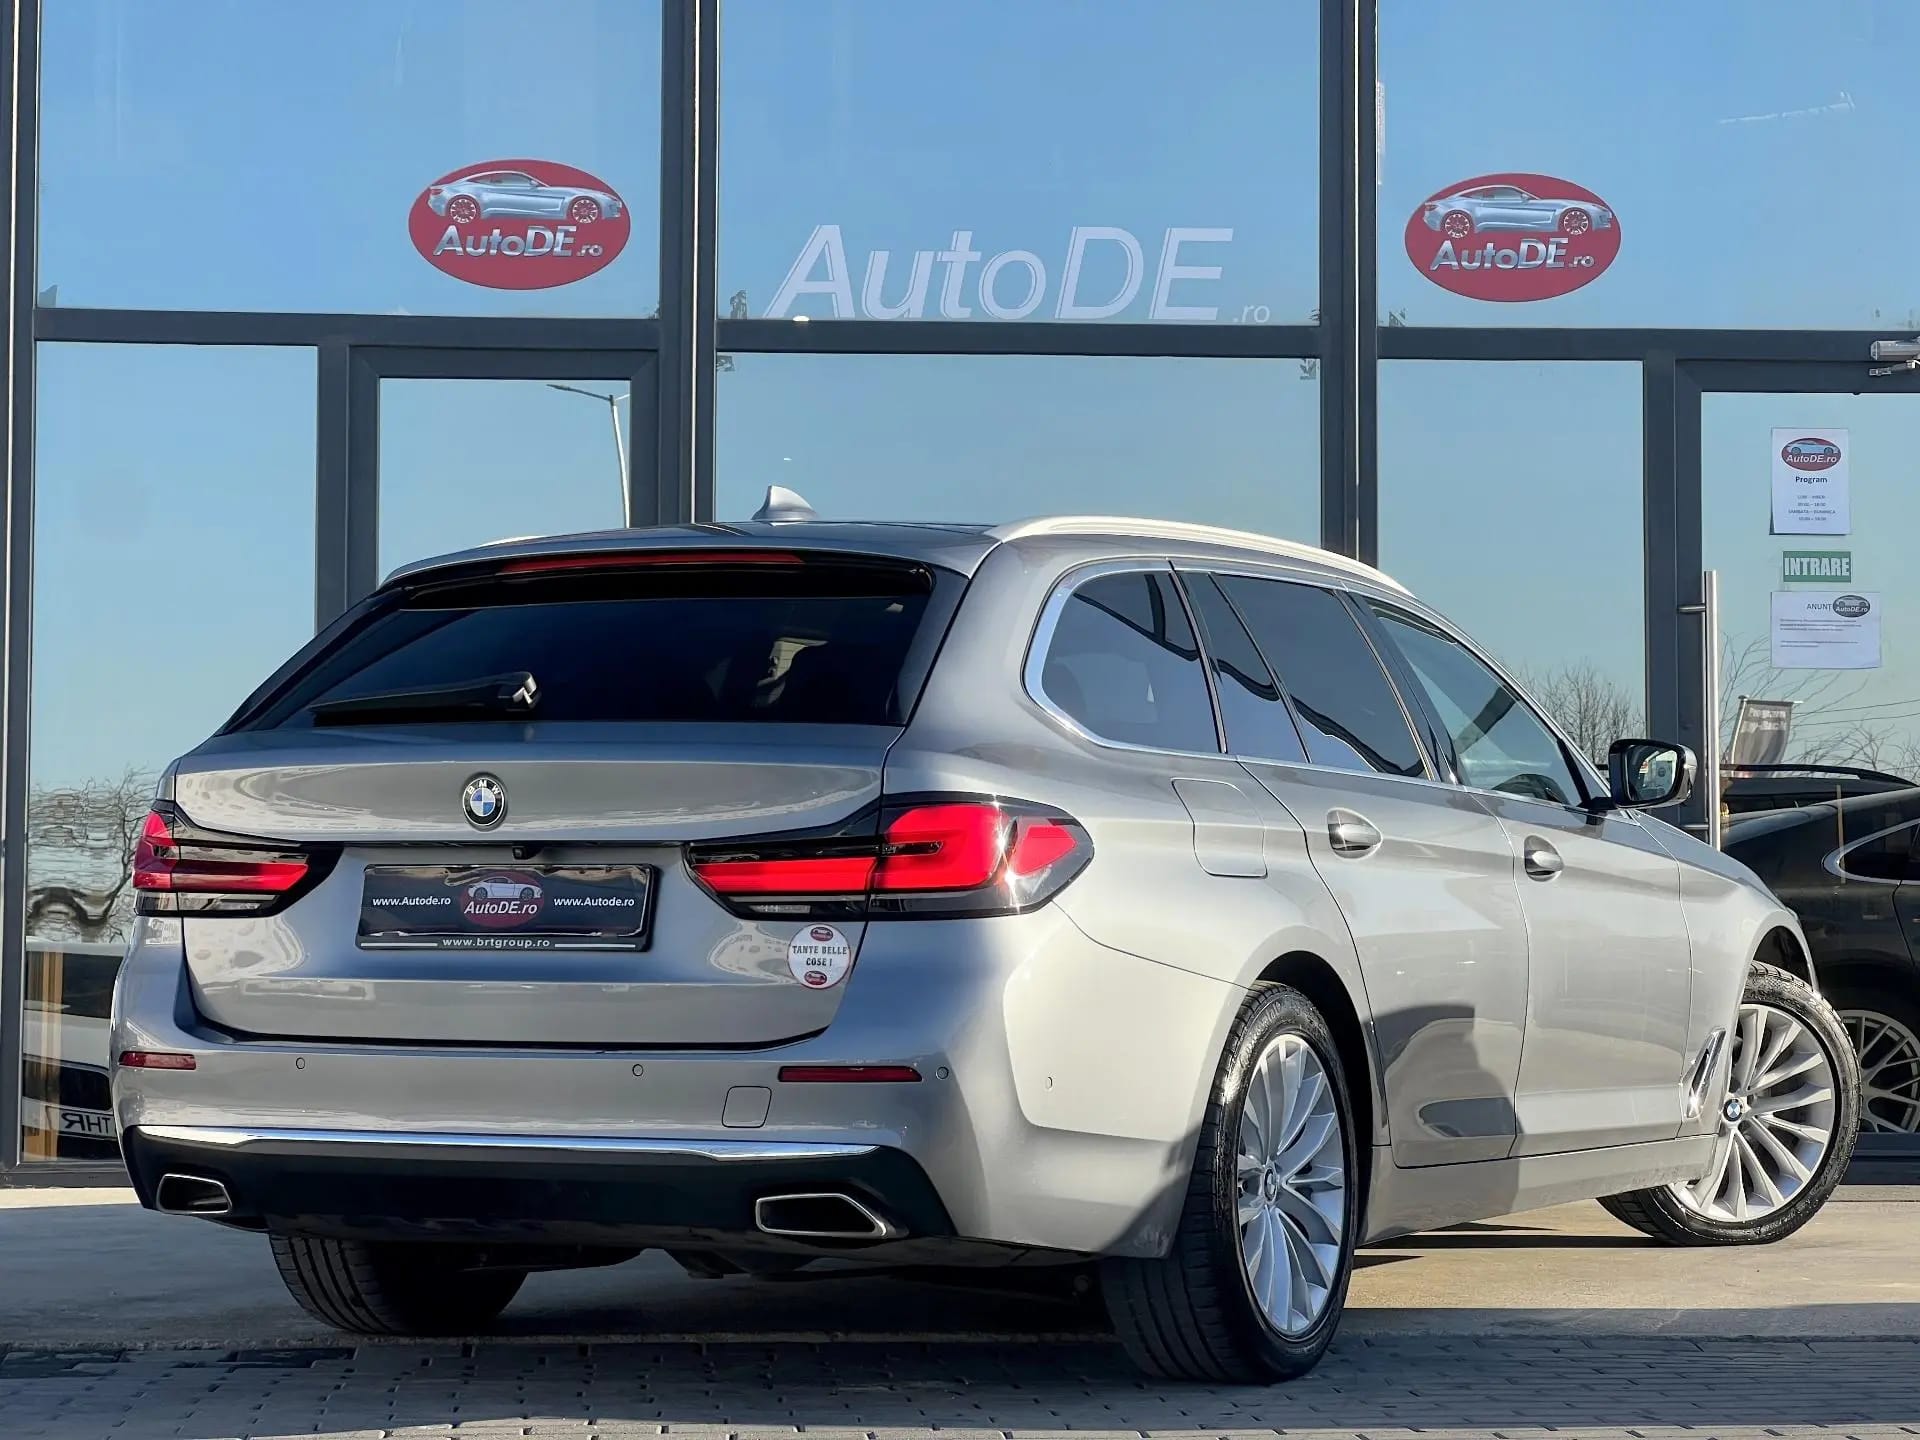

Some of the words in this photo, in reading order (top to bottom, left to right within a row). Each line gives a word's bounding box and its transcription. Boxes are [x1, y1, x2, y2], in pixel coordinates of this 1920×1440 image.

[1786, 454, 1837, 463] AutoDE.ro
[1795, 476, 1828, 484] Program
[1784, 557, 1850, 576] INTRARE
[467, 780, 501, 794] BMW
[372, 896, 451, 906] www.Autode.ro
[464, 901, 538, 915] AutoDE.ro
[553, 897, 635, 907] www.Autode.ro
[442, 938, 551, 949] www.brtgroup.ro
[792, 946, 818, 954] TANTE
[822, 946, 847, 954] BELLE
[806, 958, 826, 966] COSE
